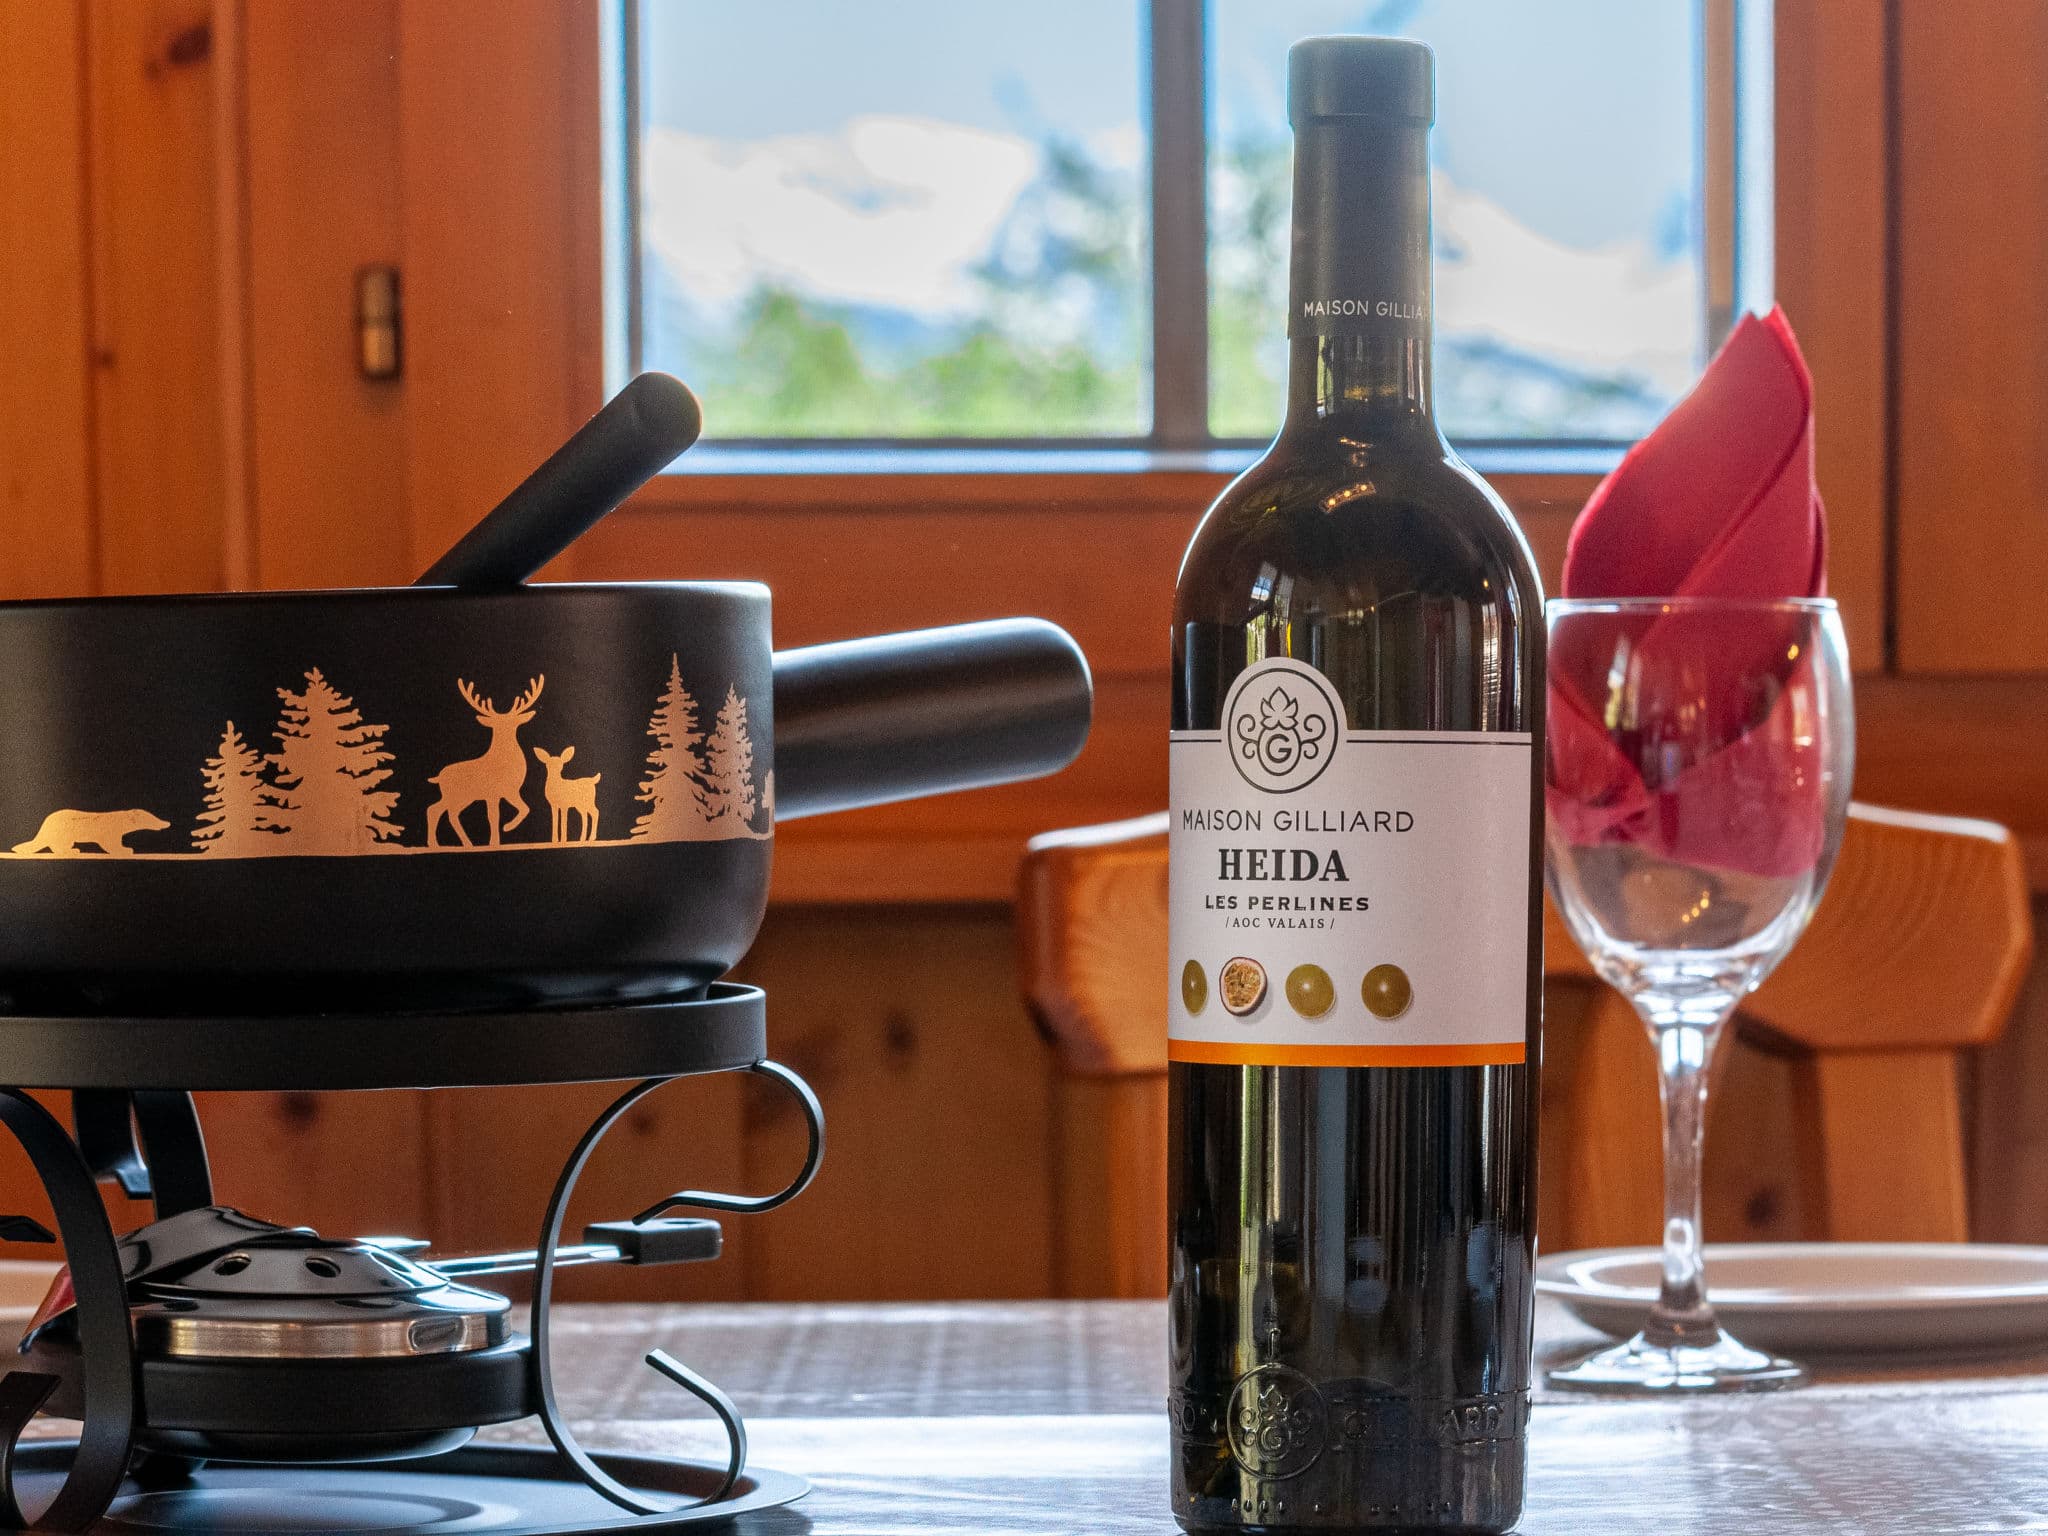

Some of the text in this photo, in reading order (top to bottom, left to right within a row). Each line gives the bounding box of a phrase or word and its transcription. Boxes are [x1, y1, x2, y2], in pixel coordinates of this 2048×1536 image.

[1304, 300, 1368, 317] MAISON
[1266, 733, 1292, 764] G
[1182, 808, 1414, 833] MAISON GILLIARD
[1217, 848, 1350, 882] HEIDA
[1205, 895, 1369, 912] LES PERLINES
